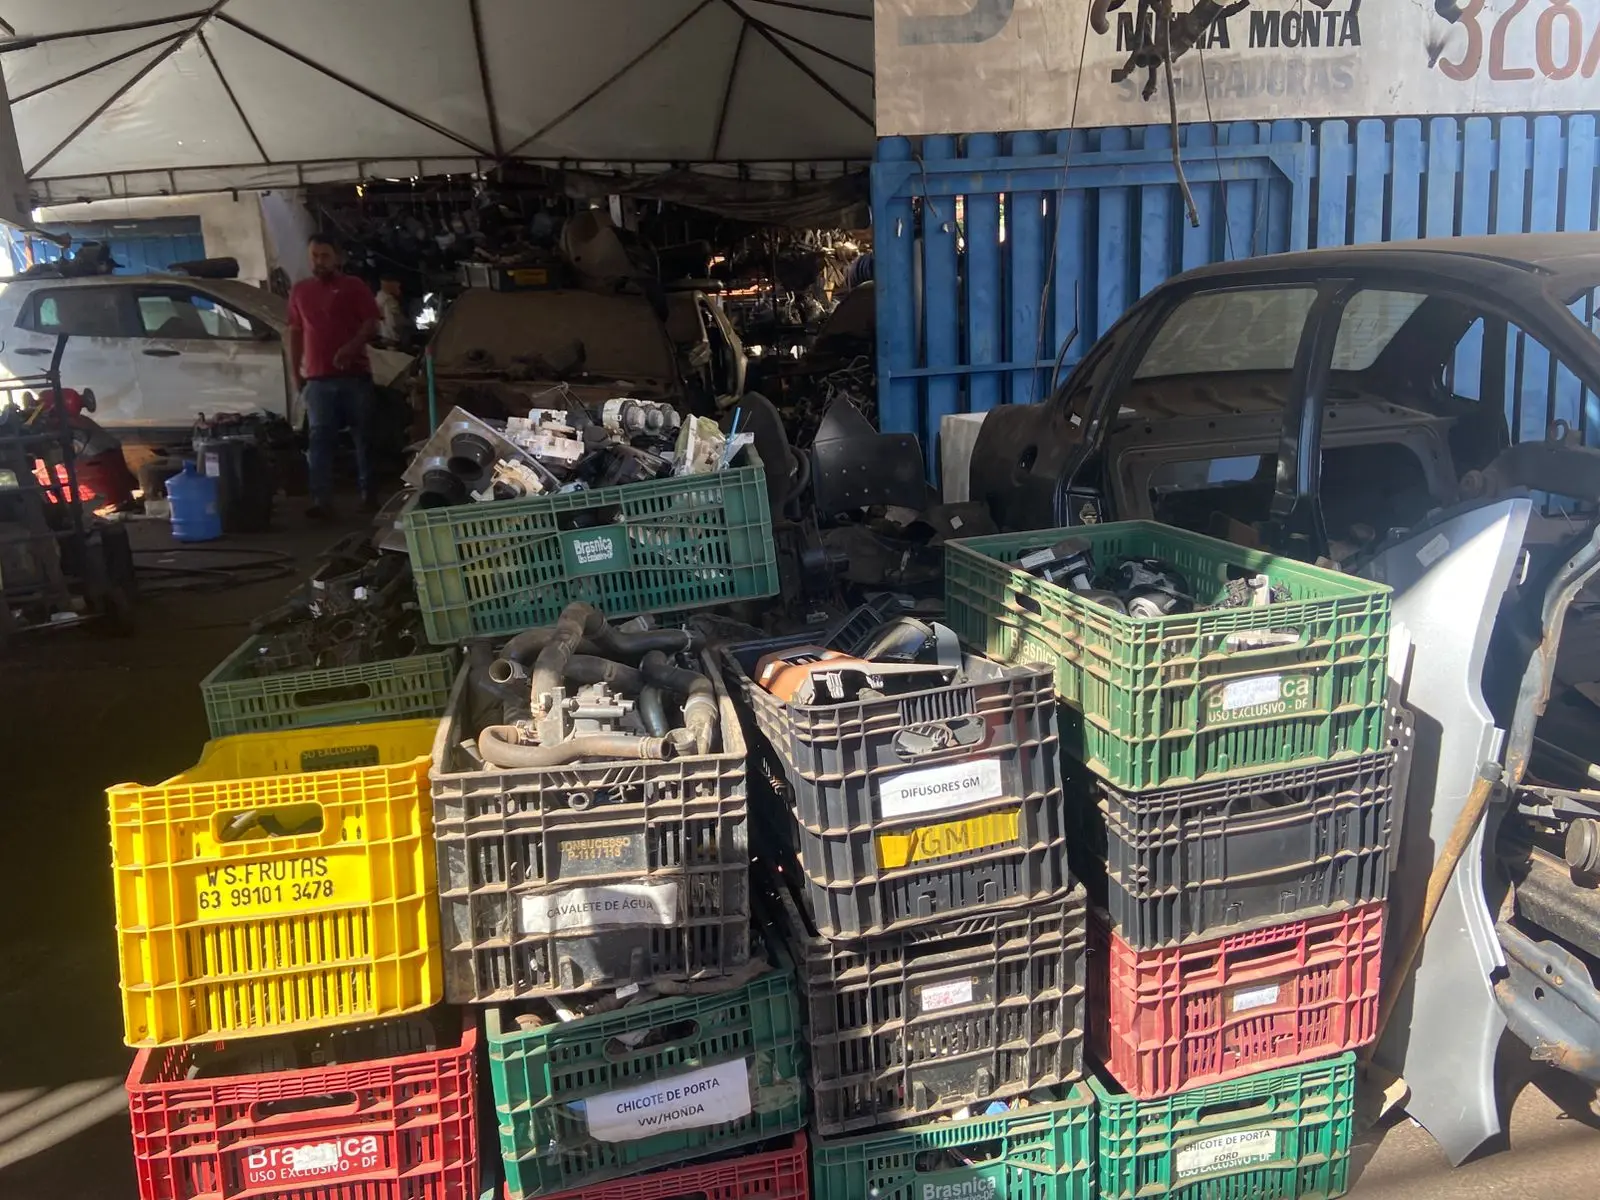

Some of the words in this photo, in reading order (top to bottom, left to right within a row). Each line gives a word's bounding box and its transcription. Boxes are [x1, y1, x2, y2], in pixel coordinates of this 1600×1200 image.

[1249, 10, 1362, 49] MONTA
[1208, 710, 1230, 723] USO
[1232, 701, 1286, 719] EXCLUSIVO
[1295, 698, 1308, 710] DF
[900, 780, 961, 799] DIFUSORES
[962, 776, 981, 789] GM
[920, 822, 970, 857] GM
[199, 890, 221, 909] 63
[231, 885, 281, 907] 99101
[292, 879, 333, 902] 3478
[546, 901, 601, 919] CAVALETE
[604, 900, 619, 911] DE
[622, 897, 654, 910] ÁGUA
[616, 1092, 664, 1114] CHICOTE
[666, 1088, 681, 1102] DE
[684, 1077, 720, 1097] PORTA
[638, 1104, 705, 1126] VW/HONDA
[248, 1135, 378, 1169] Braica
[1184, 1138, 1223, 1152] CHICOTE
[1226, 1135, 1238, 1145] DE
[1239, 1130, 1270, 1142] PORTA
[250, 1169, 277, 1183] USO
[280, 1160, 350, 1179] EXCLUSIVO
[361, 1155, 378, 1168] DF
[1214, 1151, 1239, 1162] FORD
[923, 1176, 996, 1200] Brasnica
